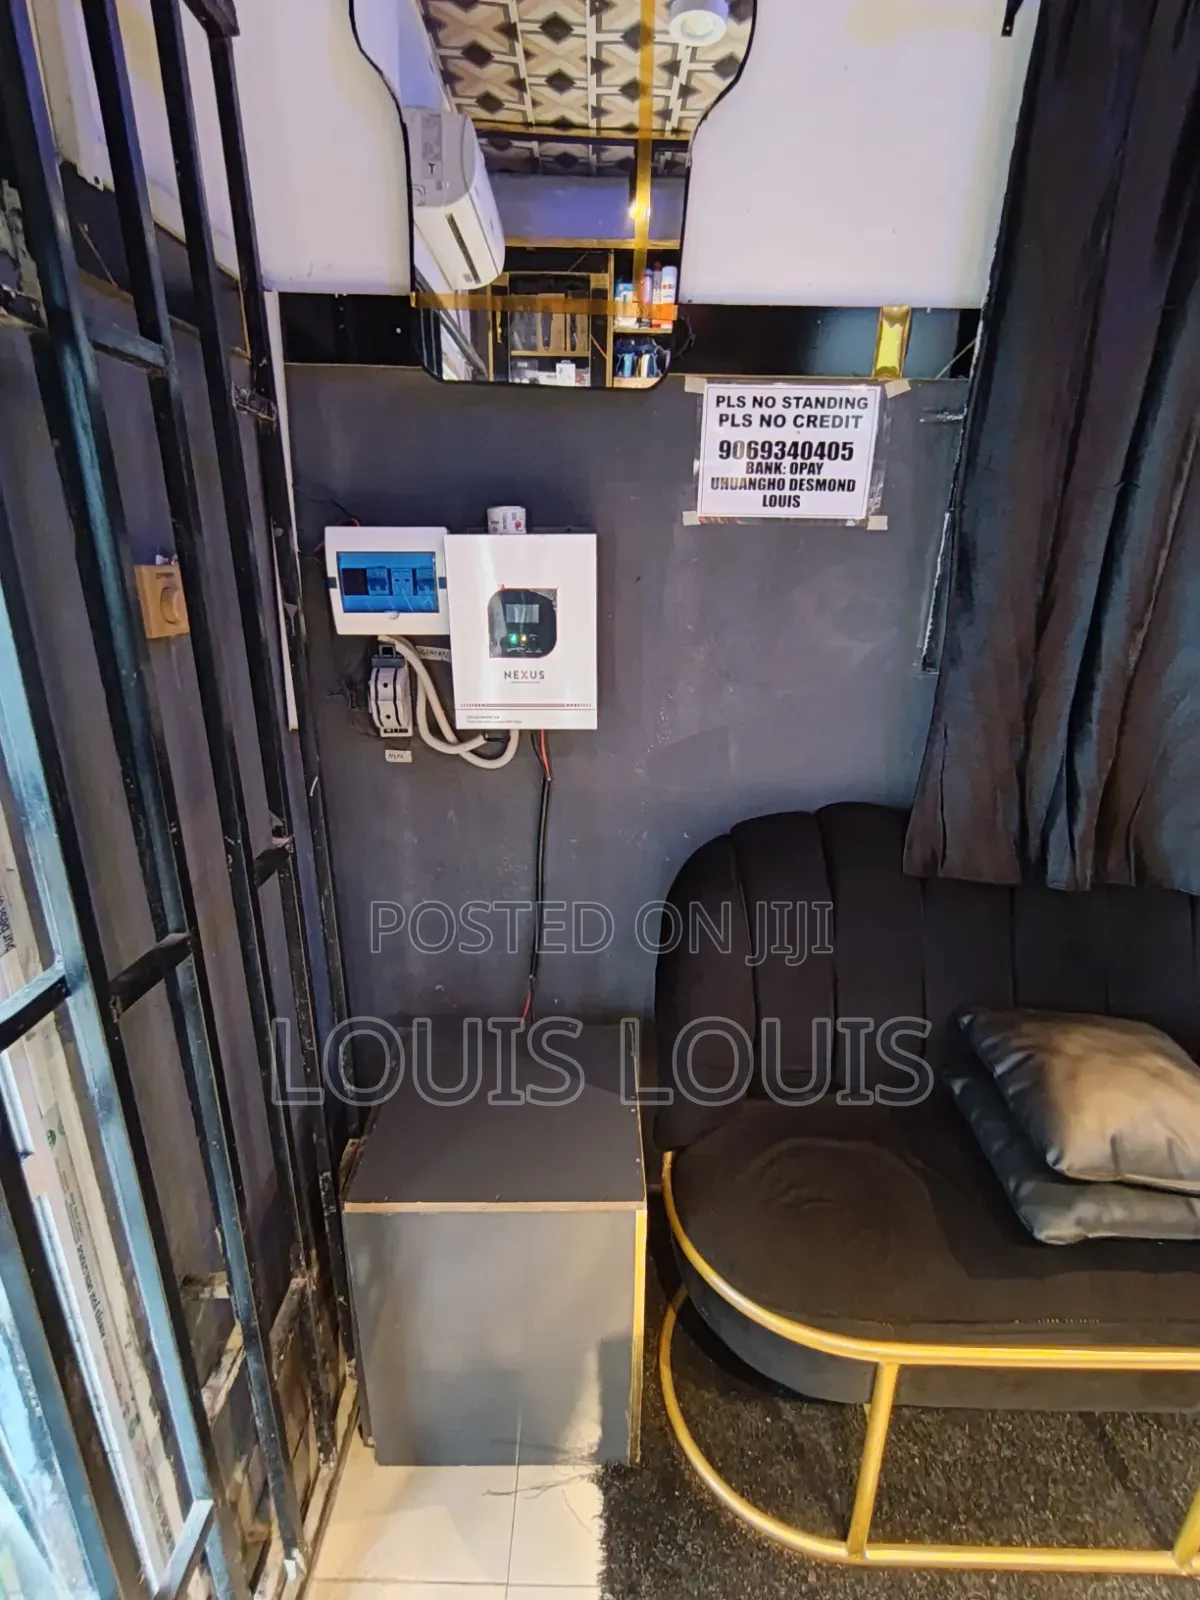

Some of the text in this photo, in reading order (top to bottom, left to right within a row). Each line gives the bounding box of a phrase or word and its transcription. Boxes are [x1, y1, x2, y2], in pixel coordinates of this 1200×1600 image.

[715, 395, 868, 410] PLS NO STANDING
[718, 413, 863, 429] PLS NO CREDIT
[718, 440, 854, 461] 9069340405
[745, 462, 824, 475] BANK: OPAY
[788, 478, 856, 492] DESMOND
[762, 494, 801, 508] LOUIS
[503, 670, 545, 680] NEXUS
